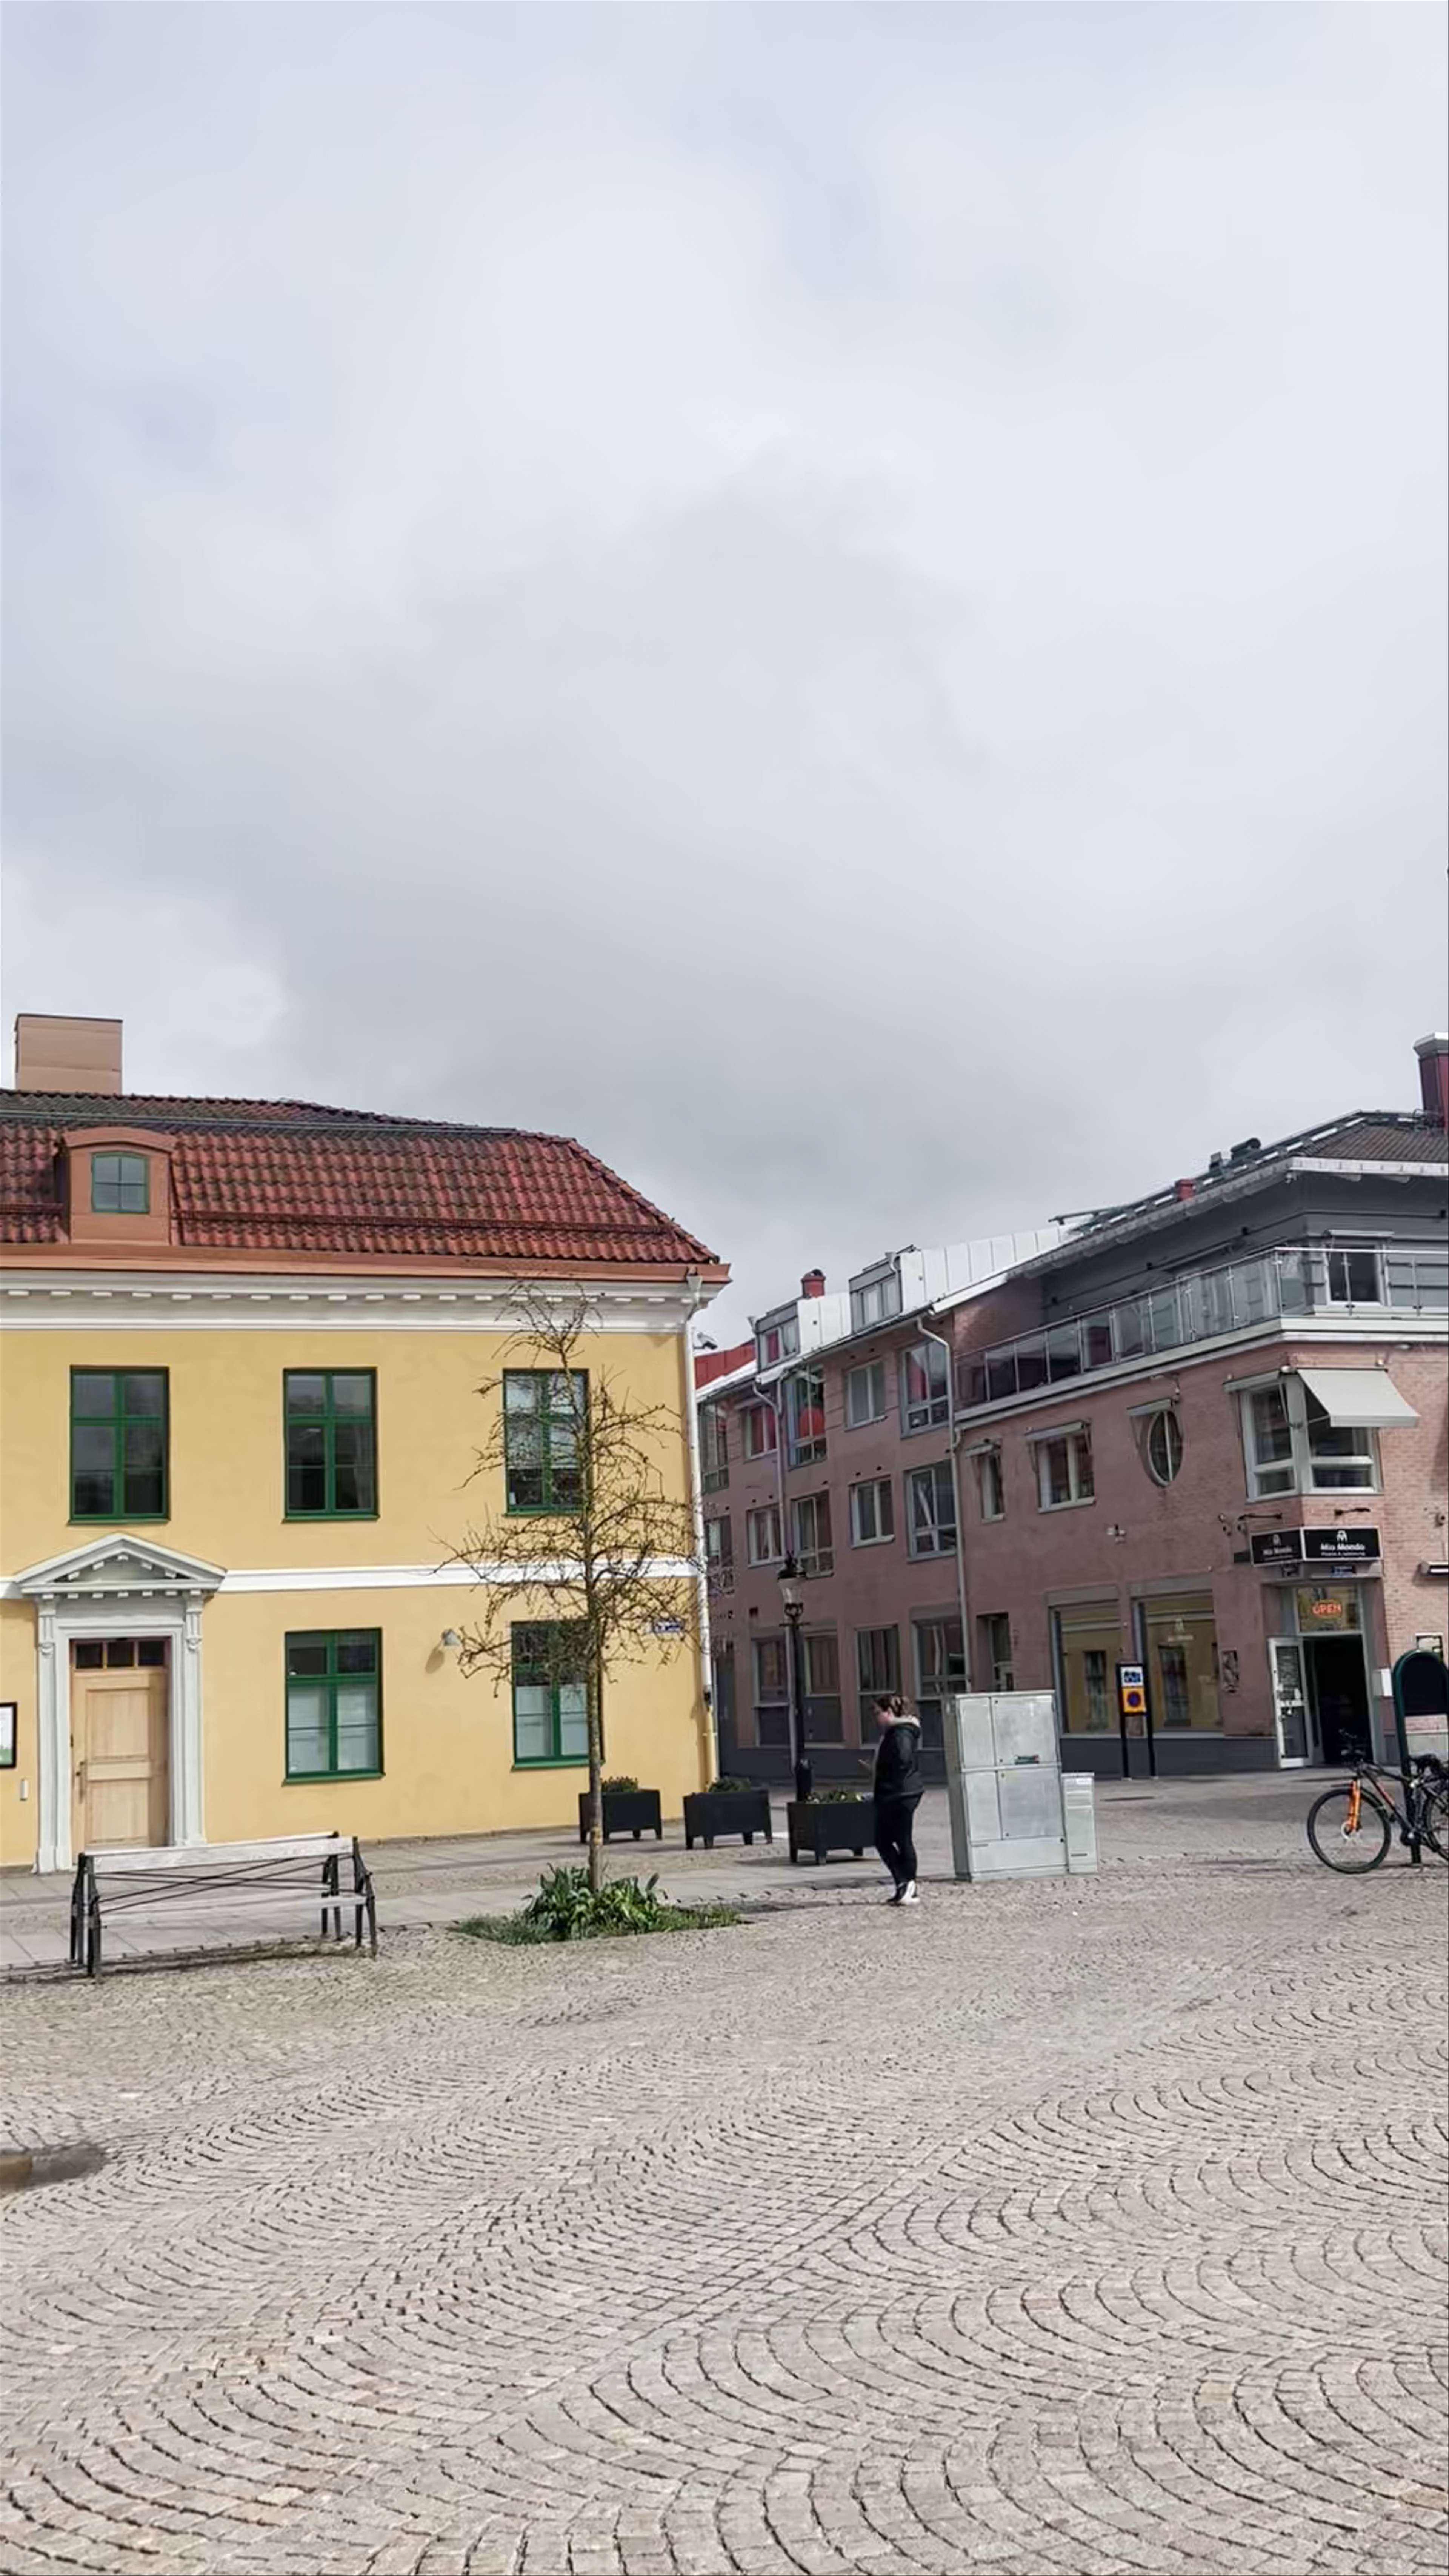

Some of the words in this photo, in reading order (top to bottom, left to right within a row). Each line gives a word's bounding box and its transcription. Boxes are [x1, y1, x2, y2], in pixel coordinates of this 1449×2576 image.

[1320, 1543, 1335, 1551] Mio
[1337, 1543, 1366, 1551] Mondo
[1312, 1603, 1342, 1615] OPEN
